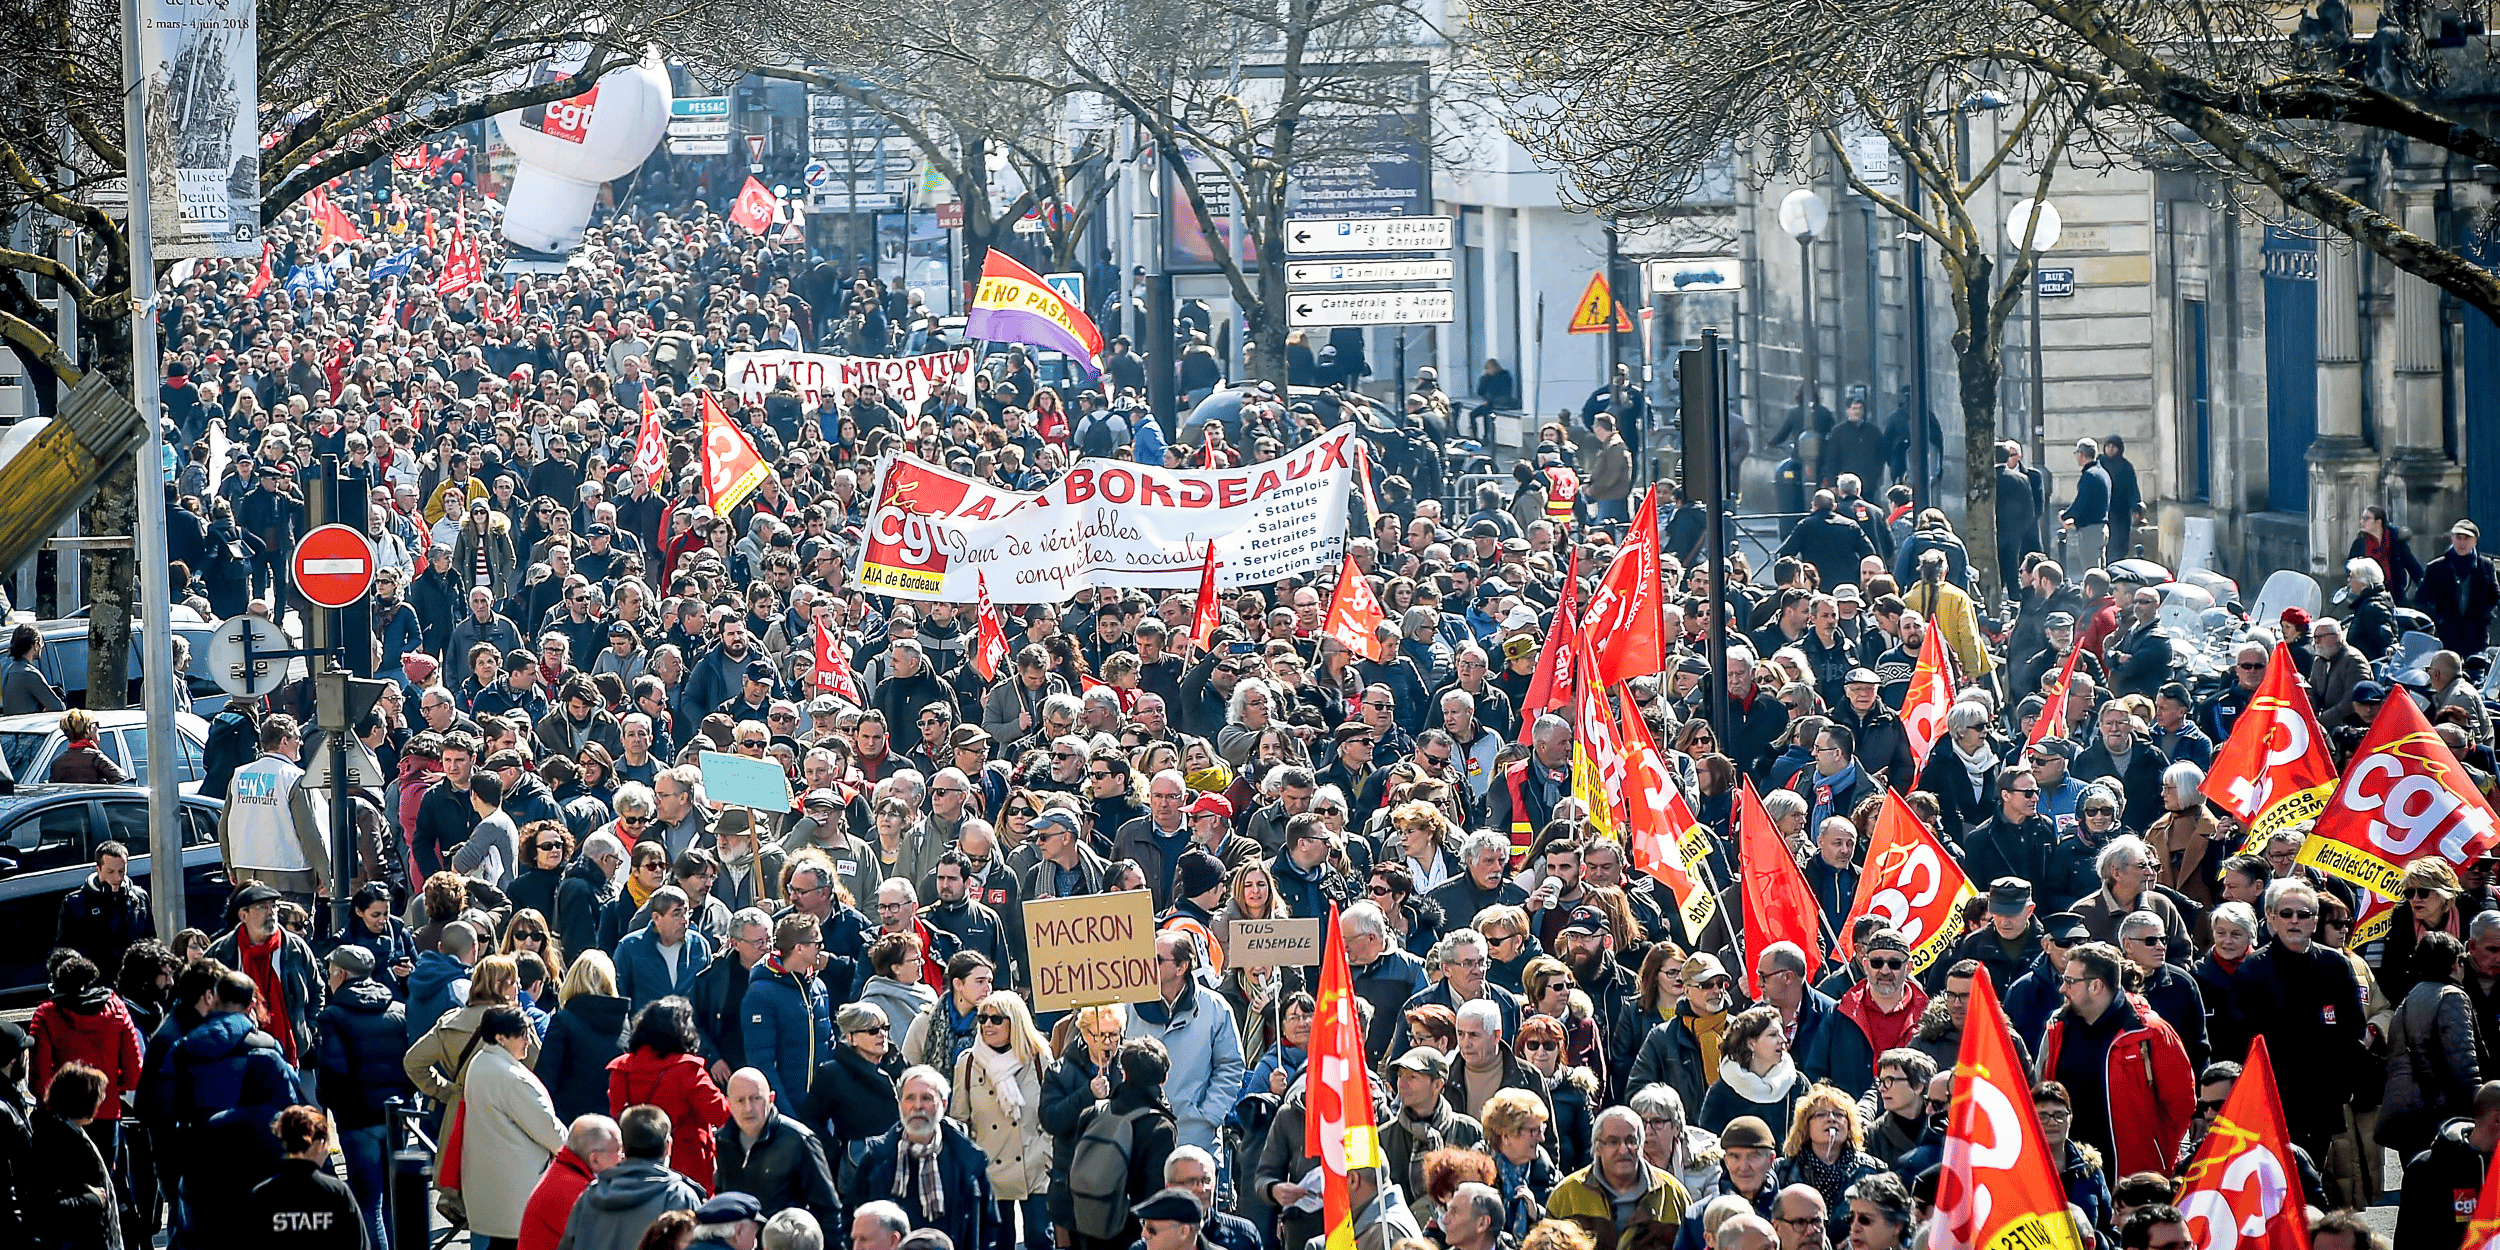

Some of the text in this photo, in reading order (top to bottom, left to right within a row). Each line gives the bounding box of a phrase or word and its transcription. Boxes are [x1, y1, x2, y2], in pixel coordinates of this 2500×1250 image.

[146, 18, 153, 29] 2
[156, 20, 181, 29] mars
[190, 18, 196, 29] 4
[199, 18, 220, 30] juin
[223, 18, 250, 29] 2018
[546, 100, 594, 131] cgt
[688, 101, 726, 113] PESSAC
[178, 169, 225, 182] Musée
[178, 189, 226, 203] beaux
[200, 184, 216, 192] des
[1362, 187, 1417, 199] Bordeaux
[188, 204, 228, 219] arts
[1354, 224, 1378, 234] PEY
[1387, 222, 1446, 234] BERLAND
[1346, 268, 1396, 278] Camille
[2045, 272, 2065, 281] RUE
[1394, 310, 1408, 319] de
[1417, 309, 1447, 319] Ville
[1064, 432, 1351, 510] BORDEAUX
[1272, 479, 1330, 500] Emplois
[1265, 497, 1318, 517] Statuts
[1258, 512, 1317, 534] Salaires
[870, 505, 949, 566] cgt
[948, 507, 1142, 564] Pour de véritables
[1251, 526, 1317, 550] Retraites
[1016, 541, 1117, 591] conquêtes
[1243, 545, 1305, 567] Services
[863, 565, 940, 592] AIA de Bordeaux
[1235, 555, 1310, 582] Protection
[2344, 752, 2496, 866] cgt
[2315, 843, 2358, 874] Retraités
[2357, 857, 2385, 884] CGT
[1035, 914, 1134, 948] MACRON
[1238, 922, 1275, 935] TOUS
[1248, 937, 1312, 950] ENSEMBLE
[272, 1211, 334, 1232] STAFF
